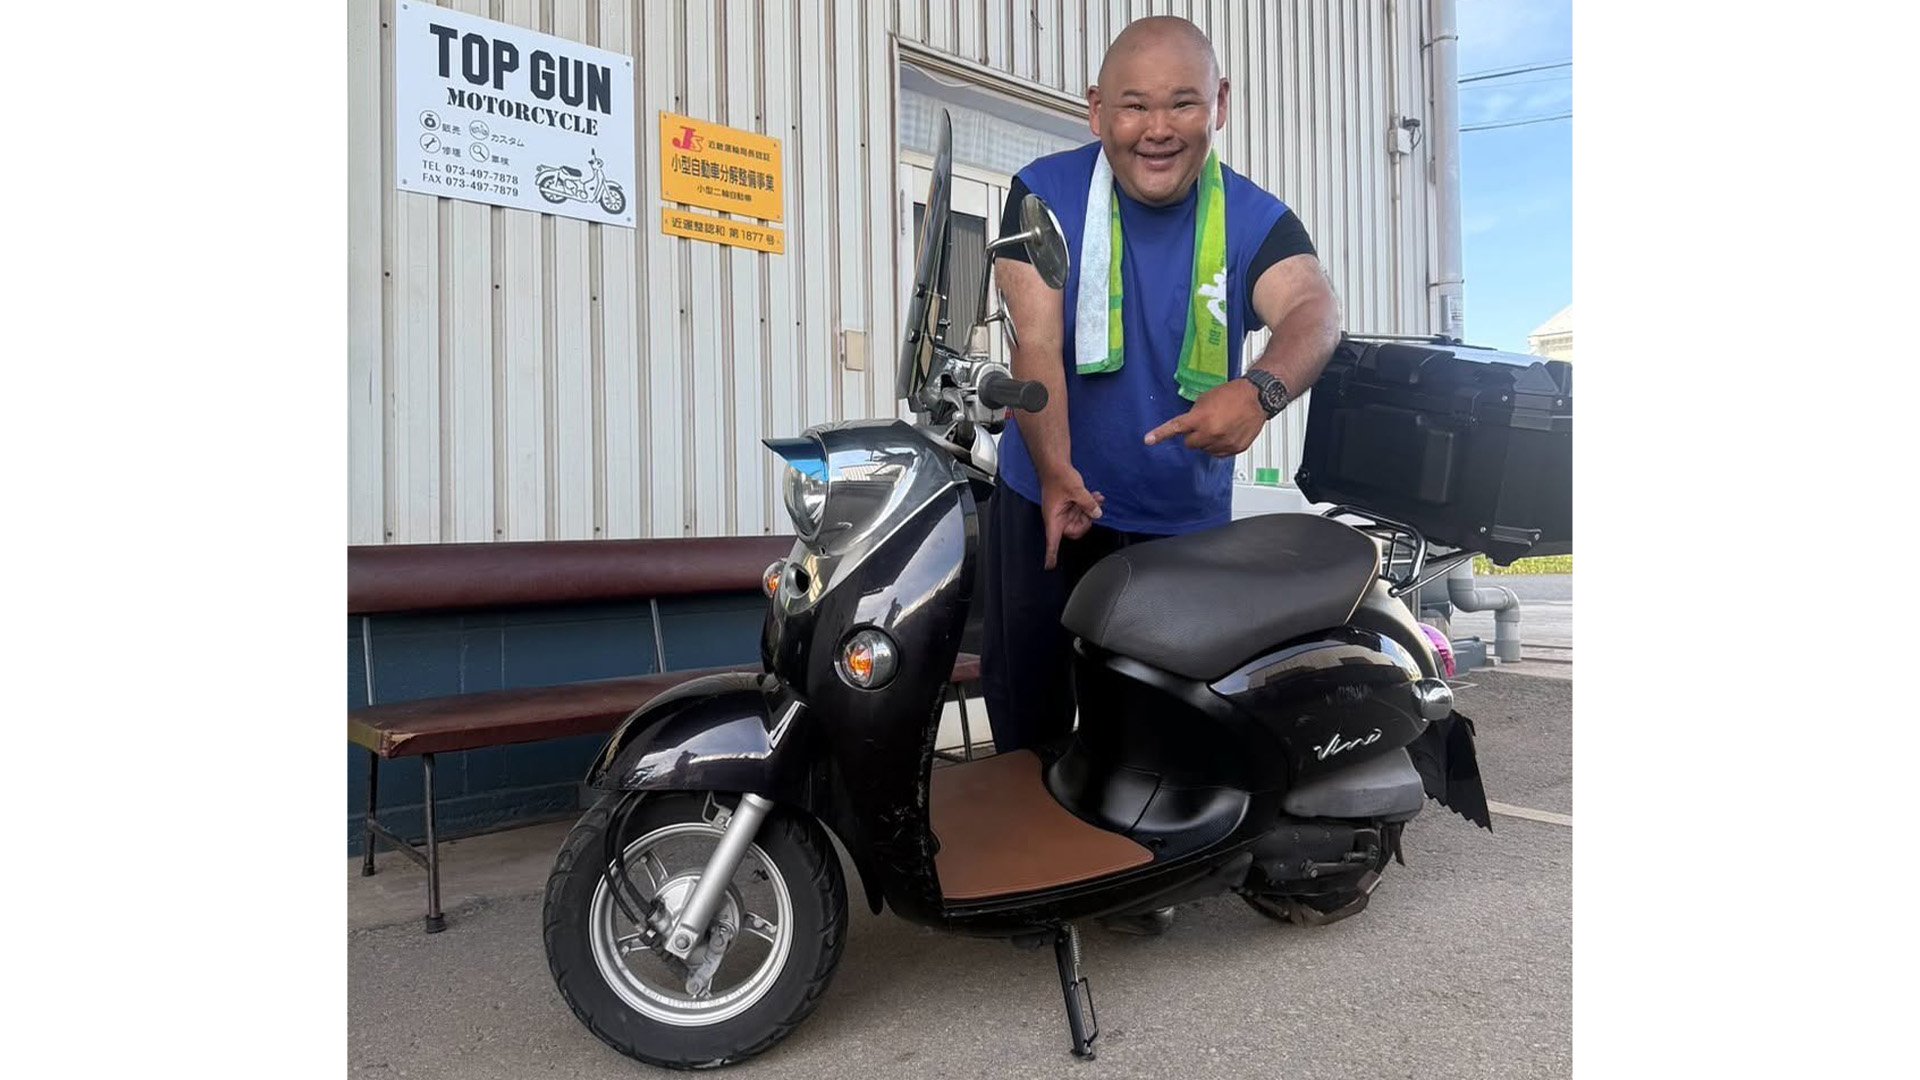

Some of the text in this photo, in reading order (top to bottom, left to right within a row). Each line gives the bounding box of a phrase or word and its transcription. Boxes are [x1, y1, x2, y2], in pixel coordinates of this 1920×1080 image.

[430, 23, 611, 115] TOP GUN
[447, 87, 598, 136] MOTORCYCLE
[442, 123, 461, 135] 販売
[491, 134, 525, 147] カスタム
[422, 160, 519, 185] TEL 073-497-7878
[671, 153, 775, 192] 小型自動車分解整備事業
[422, 173, 519, 197] FAX 073-497-7879
[697, 185, 752, 202] 小型二輪自動車
[729, 227, 739, 238] 第
[742, 230, 764, 242] 1877
